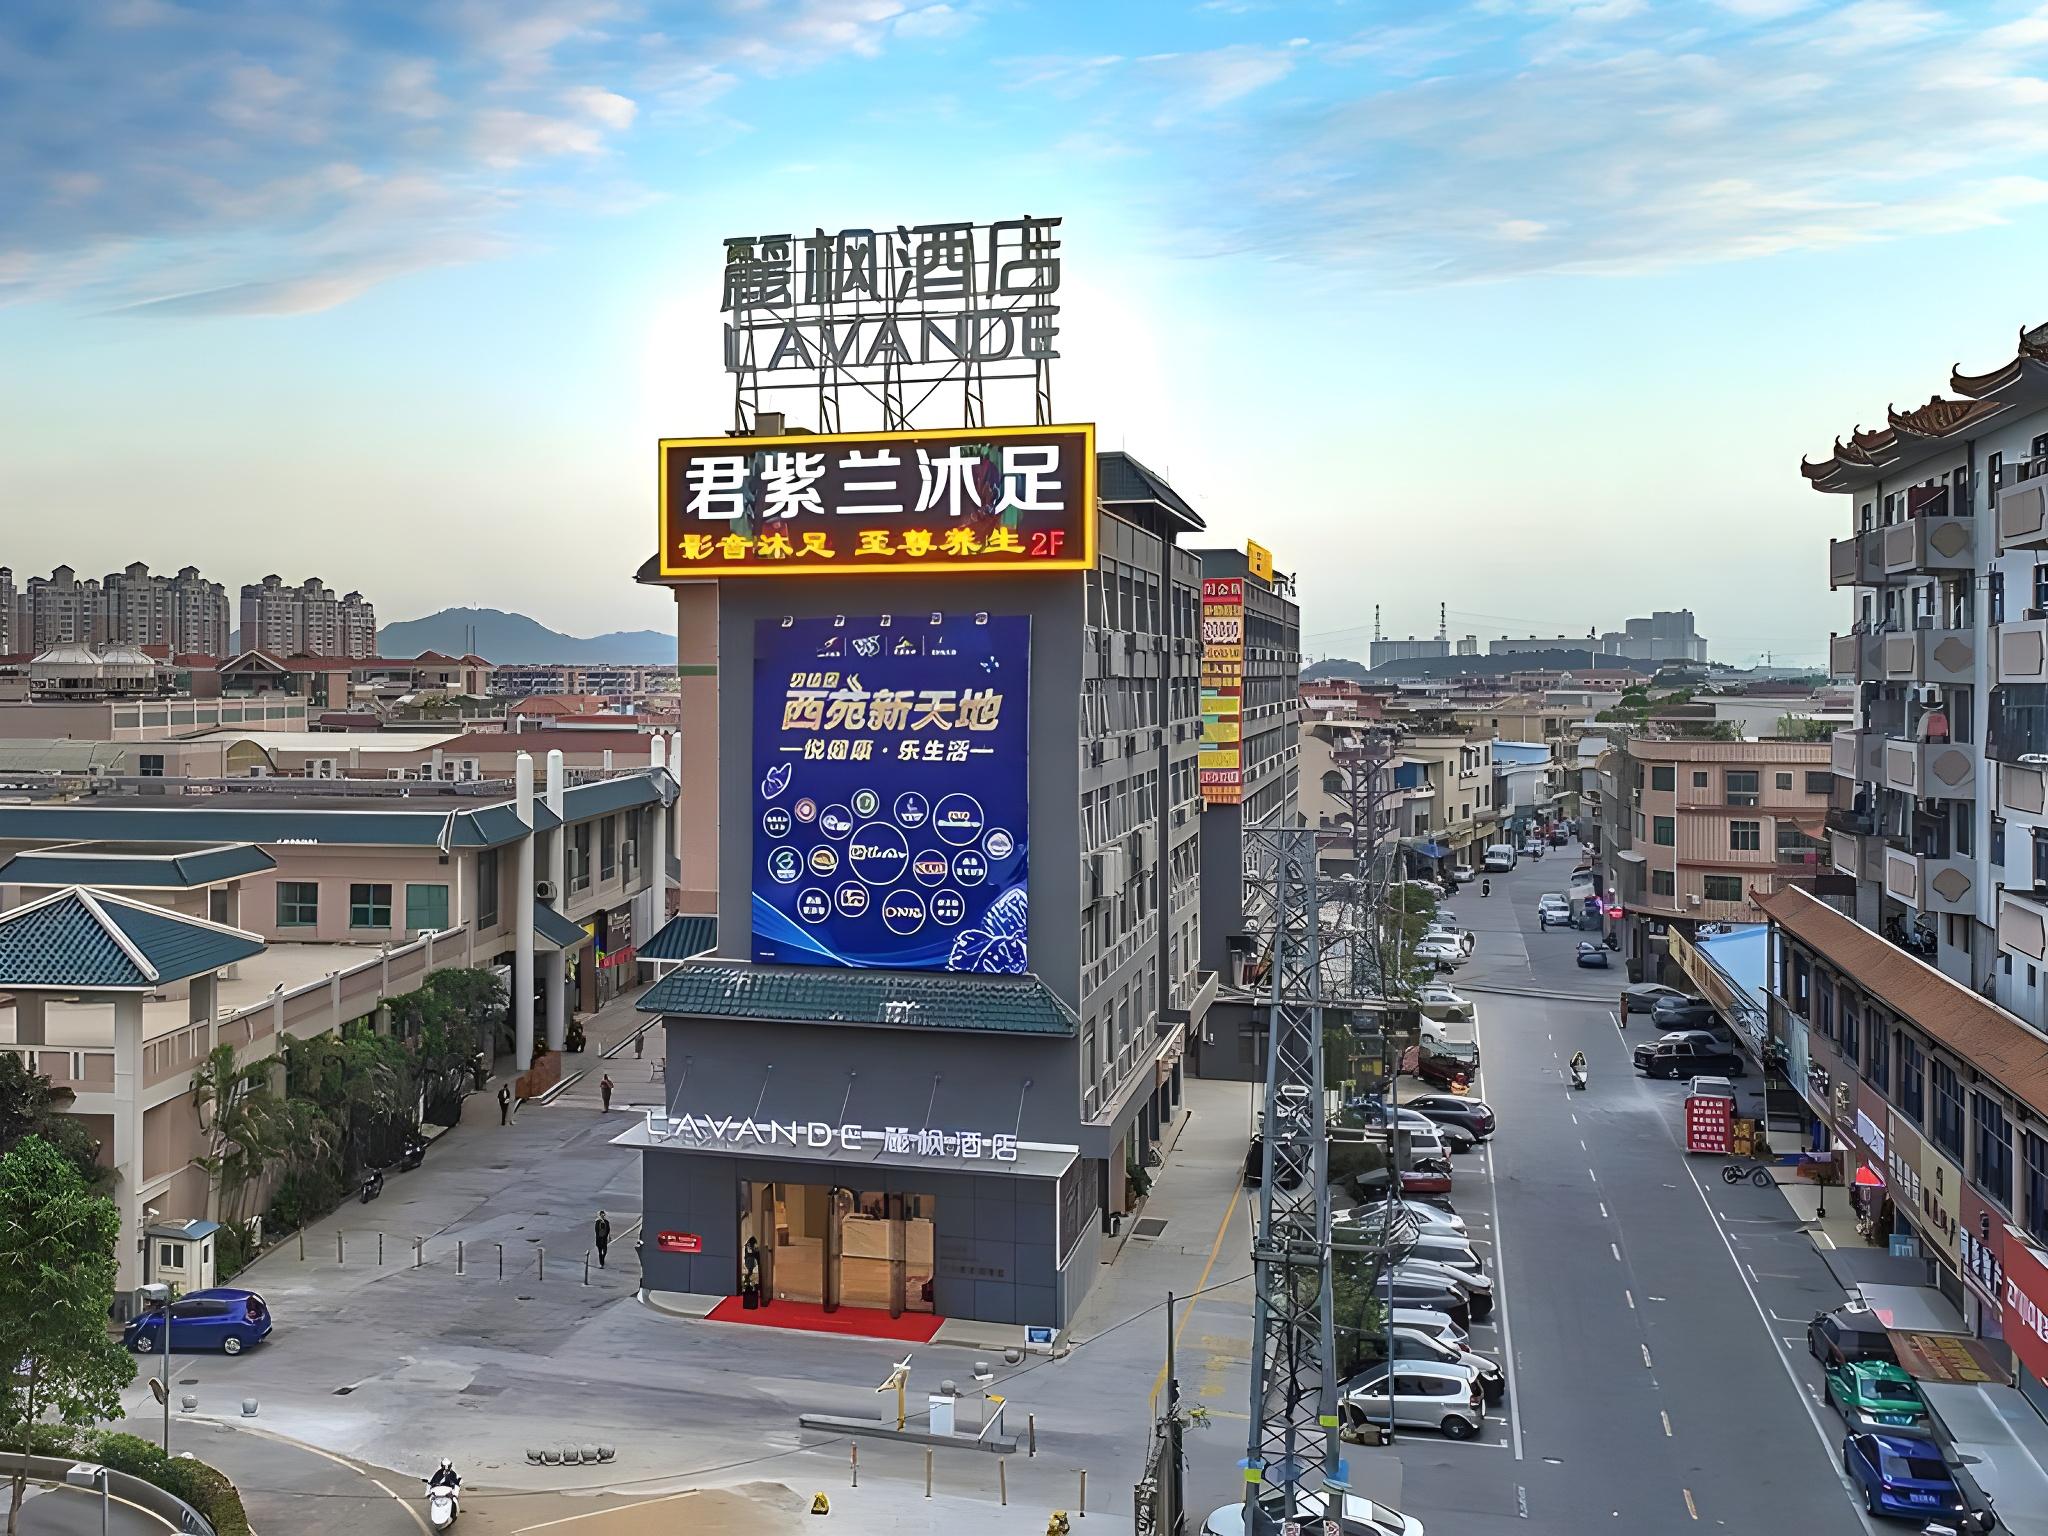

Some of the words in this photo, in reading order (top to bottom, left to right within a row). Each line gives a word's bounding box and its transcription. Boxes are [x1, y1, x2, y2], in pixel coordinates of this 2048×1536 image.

[724, 305, 1061, 372] LAVANDE
[685, 445, 1065, 520] 君紫兰沐足
[678, 531, 836, 560] 影音沐足
[854, 526, 1026, 557] 至尊养生
[1031, 531, 1065, 556] 2F
[781, 687, 1003, 731] 西苑新天地
[646, 1110, 862, 1150] LAVANDE
